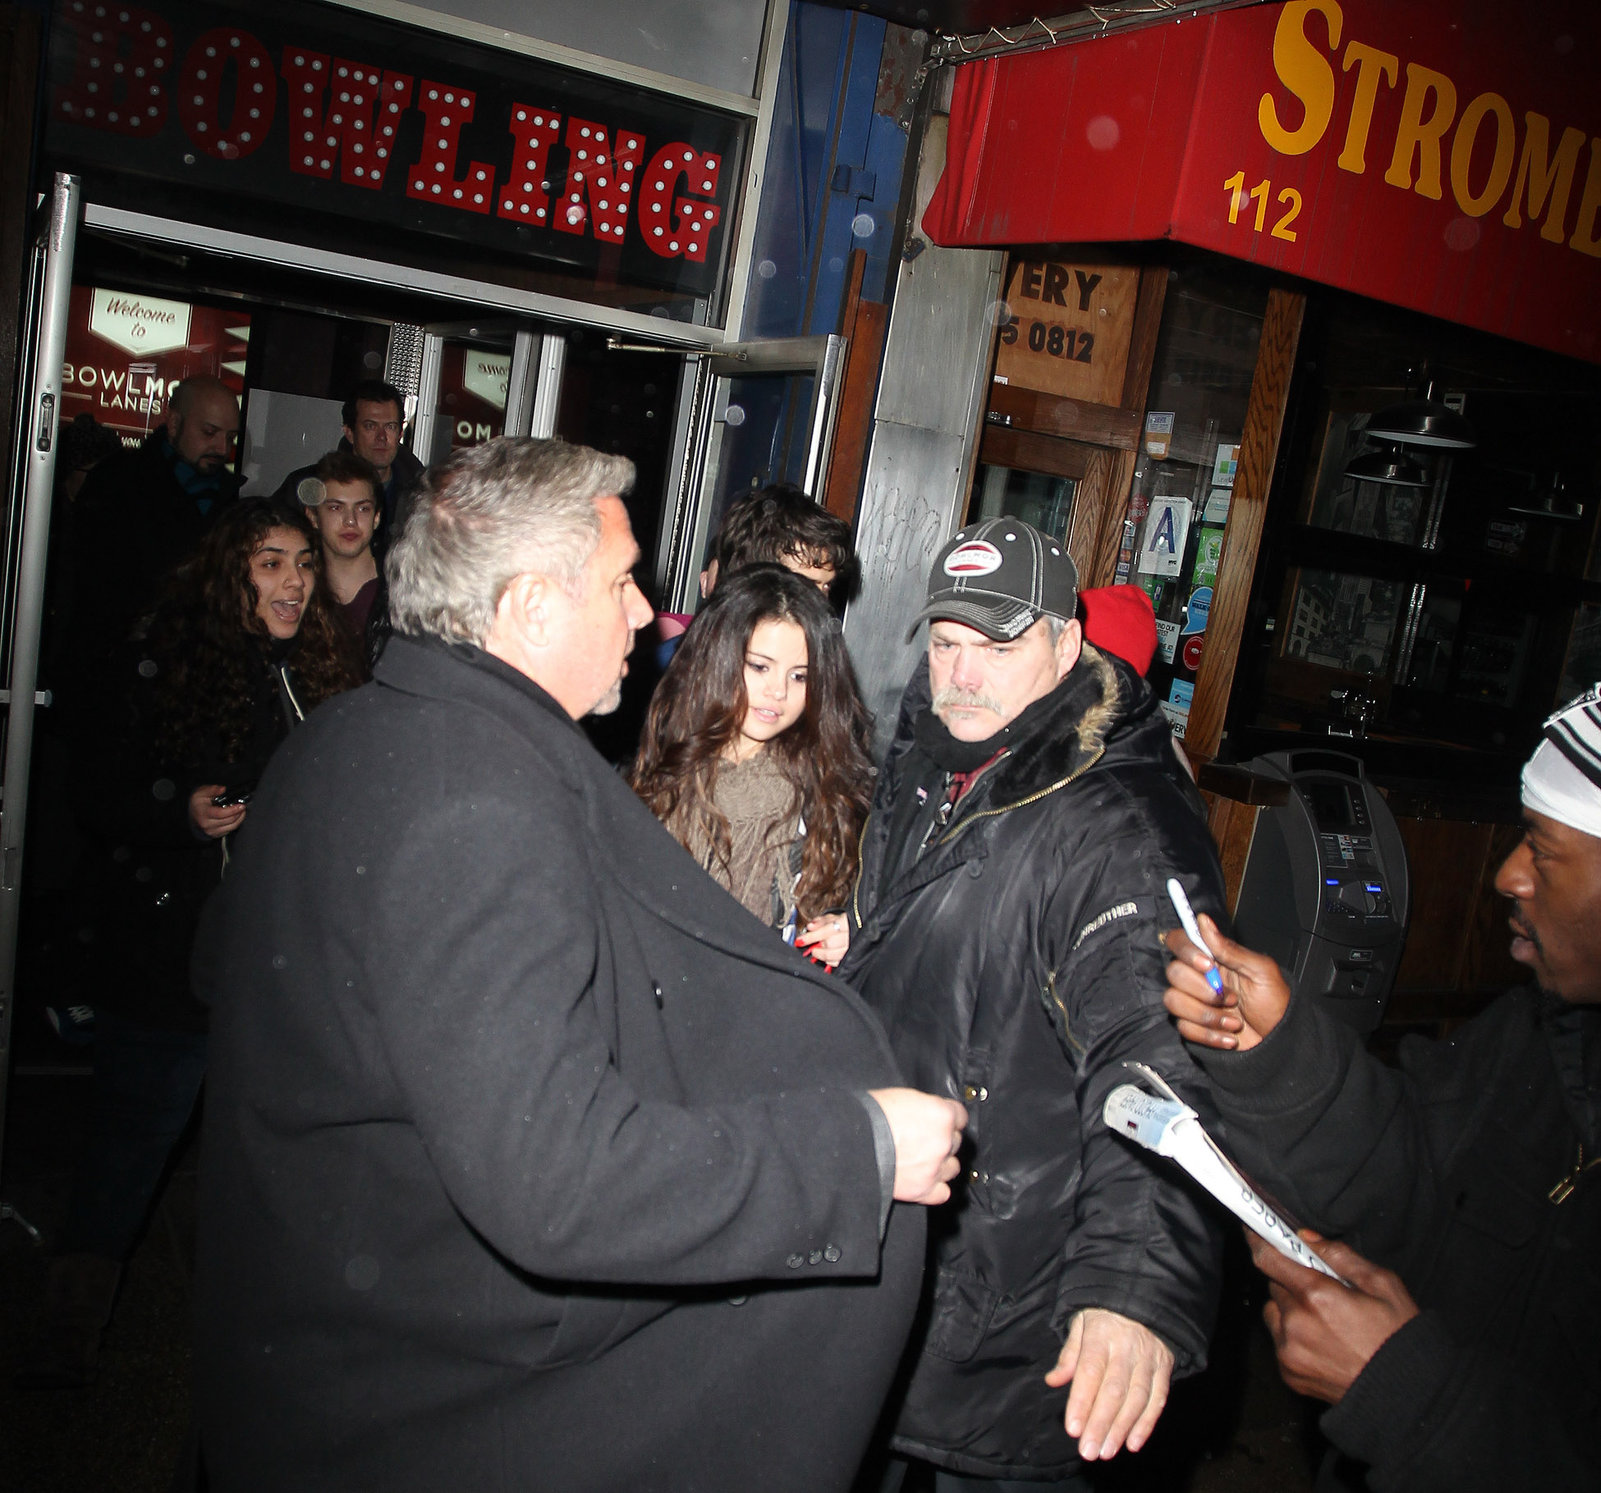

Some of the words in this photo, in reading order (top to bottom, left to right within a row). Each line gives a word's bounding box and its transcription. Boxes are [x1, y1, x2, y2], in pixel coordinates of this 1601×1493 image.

[54, 0, 722, 262] BOWLING
[1224, 171, 1302, 243] 112
[107, 296, 176, 325] Welcome
[130, 322, 147, 338] to
[1028, 321, 1095, 364] 0812
[100, 391, 162, 415] LANES
[1148, 506, 1176, 554] A
